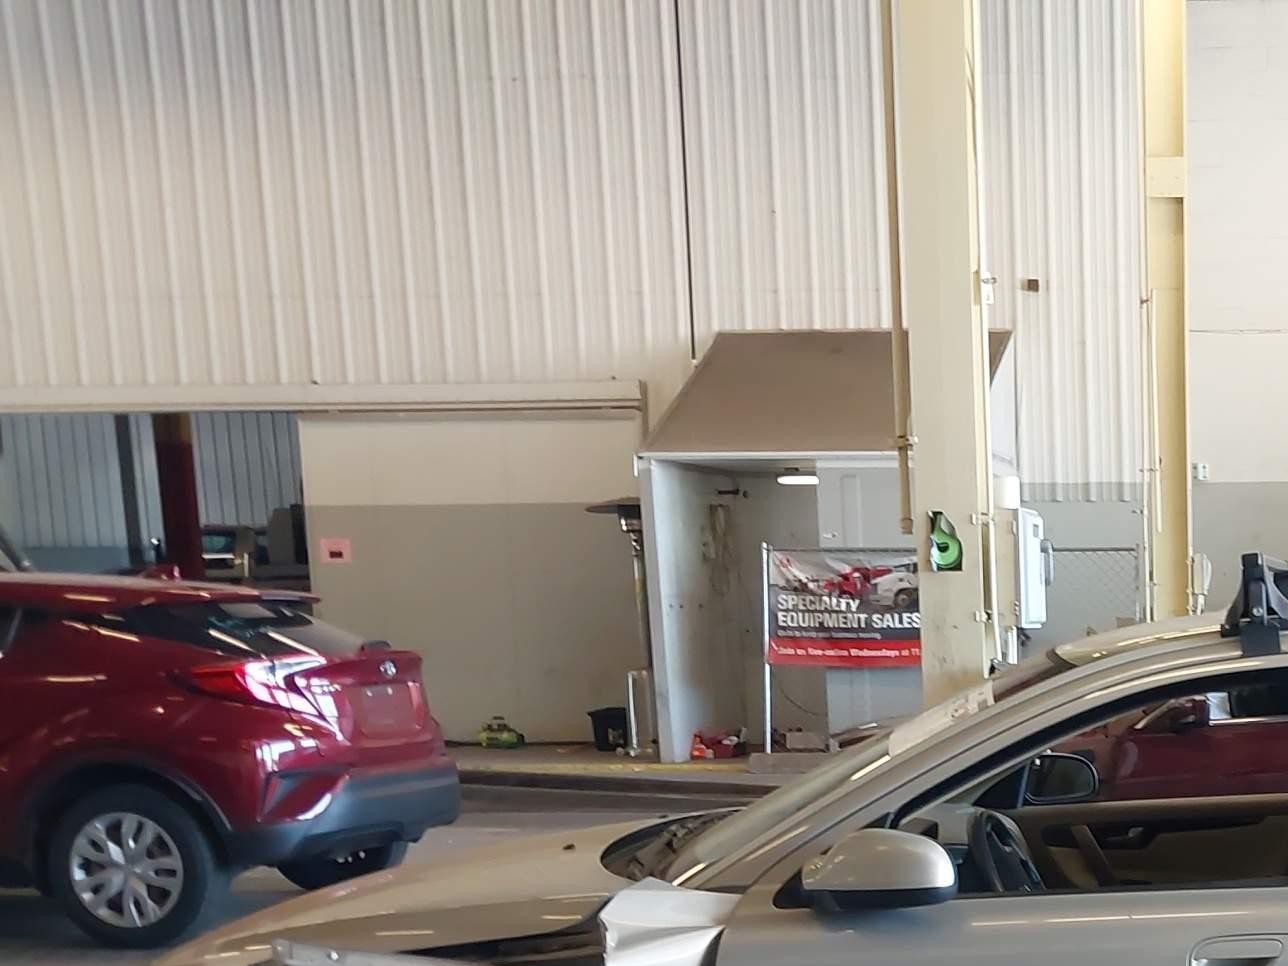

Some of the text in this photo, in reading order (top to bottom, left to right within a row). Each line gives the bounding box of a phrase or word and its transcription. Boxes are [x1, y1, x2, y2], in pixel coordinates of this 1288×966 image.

[777, 594, 860, 612] SPECIALTY
[777, 612, 921, 629] EQUIPMENT SALES
